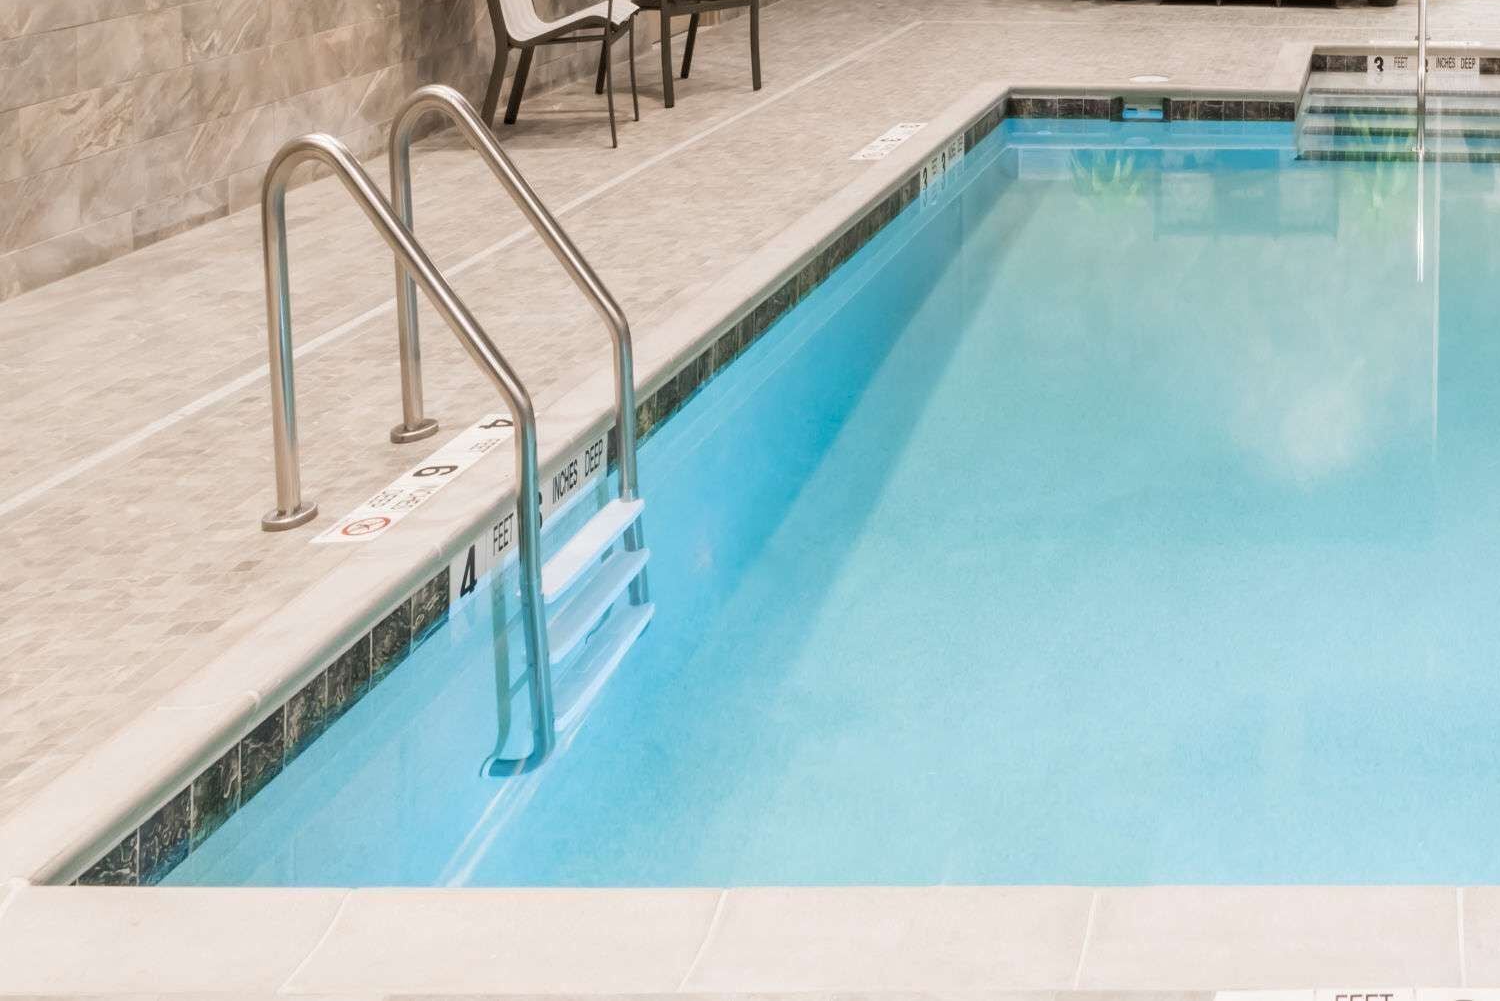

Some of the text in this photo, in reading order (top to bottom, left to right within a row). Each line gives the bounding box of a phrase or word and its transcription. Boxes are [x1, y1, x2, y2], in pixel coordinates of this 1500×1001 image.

[1435, 57, 1456, 70] INCHES
[1460, 57, 1475, 70] DEEP
[460, 438, 604, 598] 4 FEET INCHES DEEP
